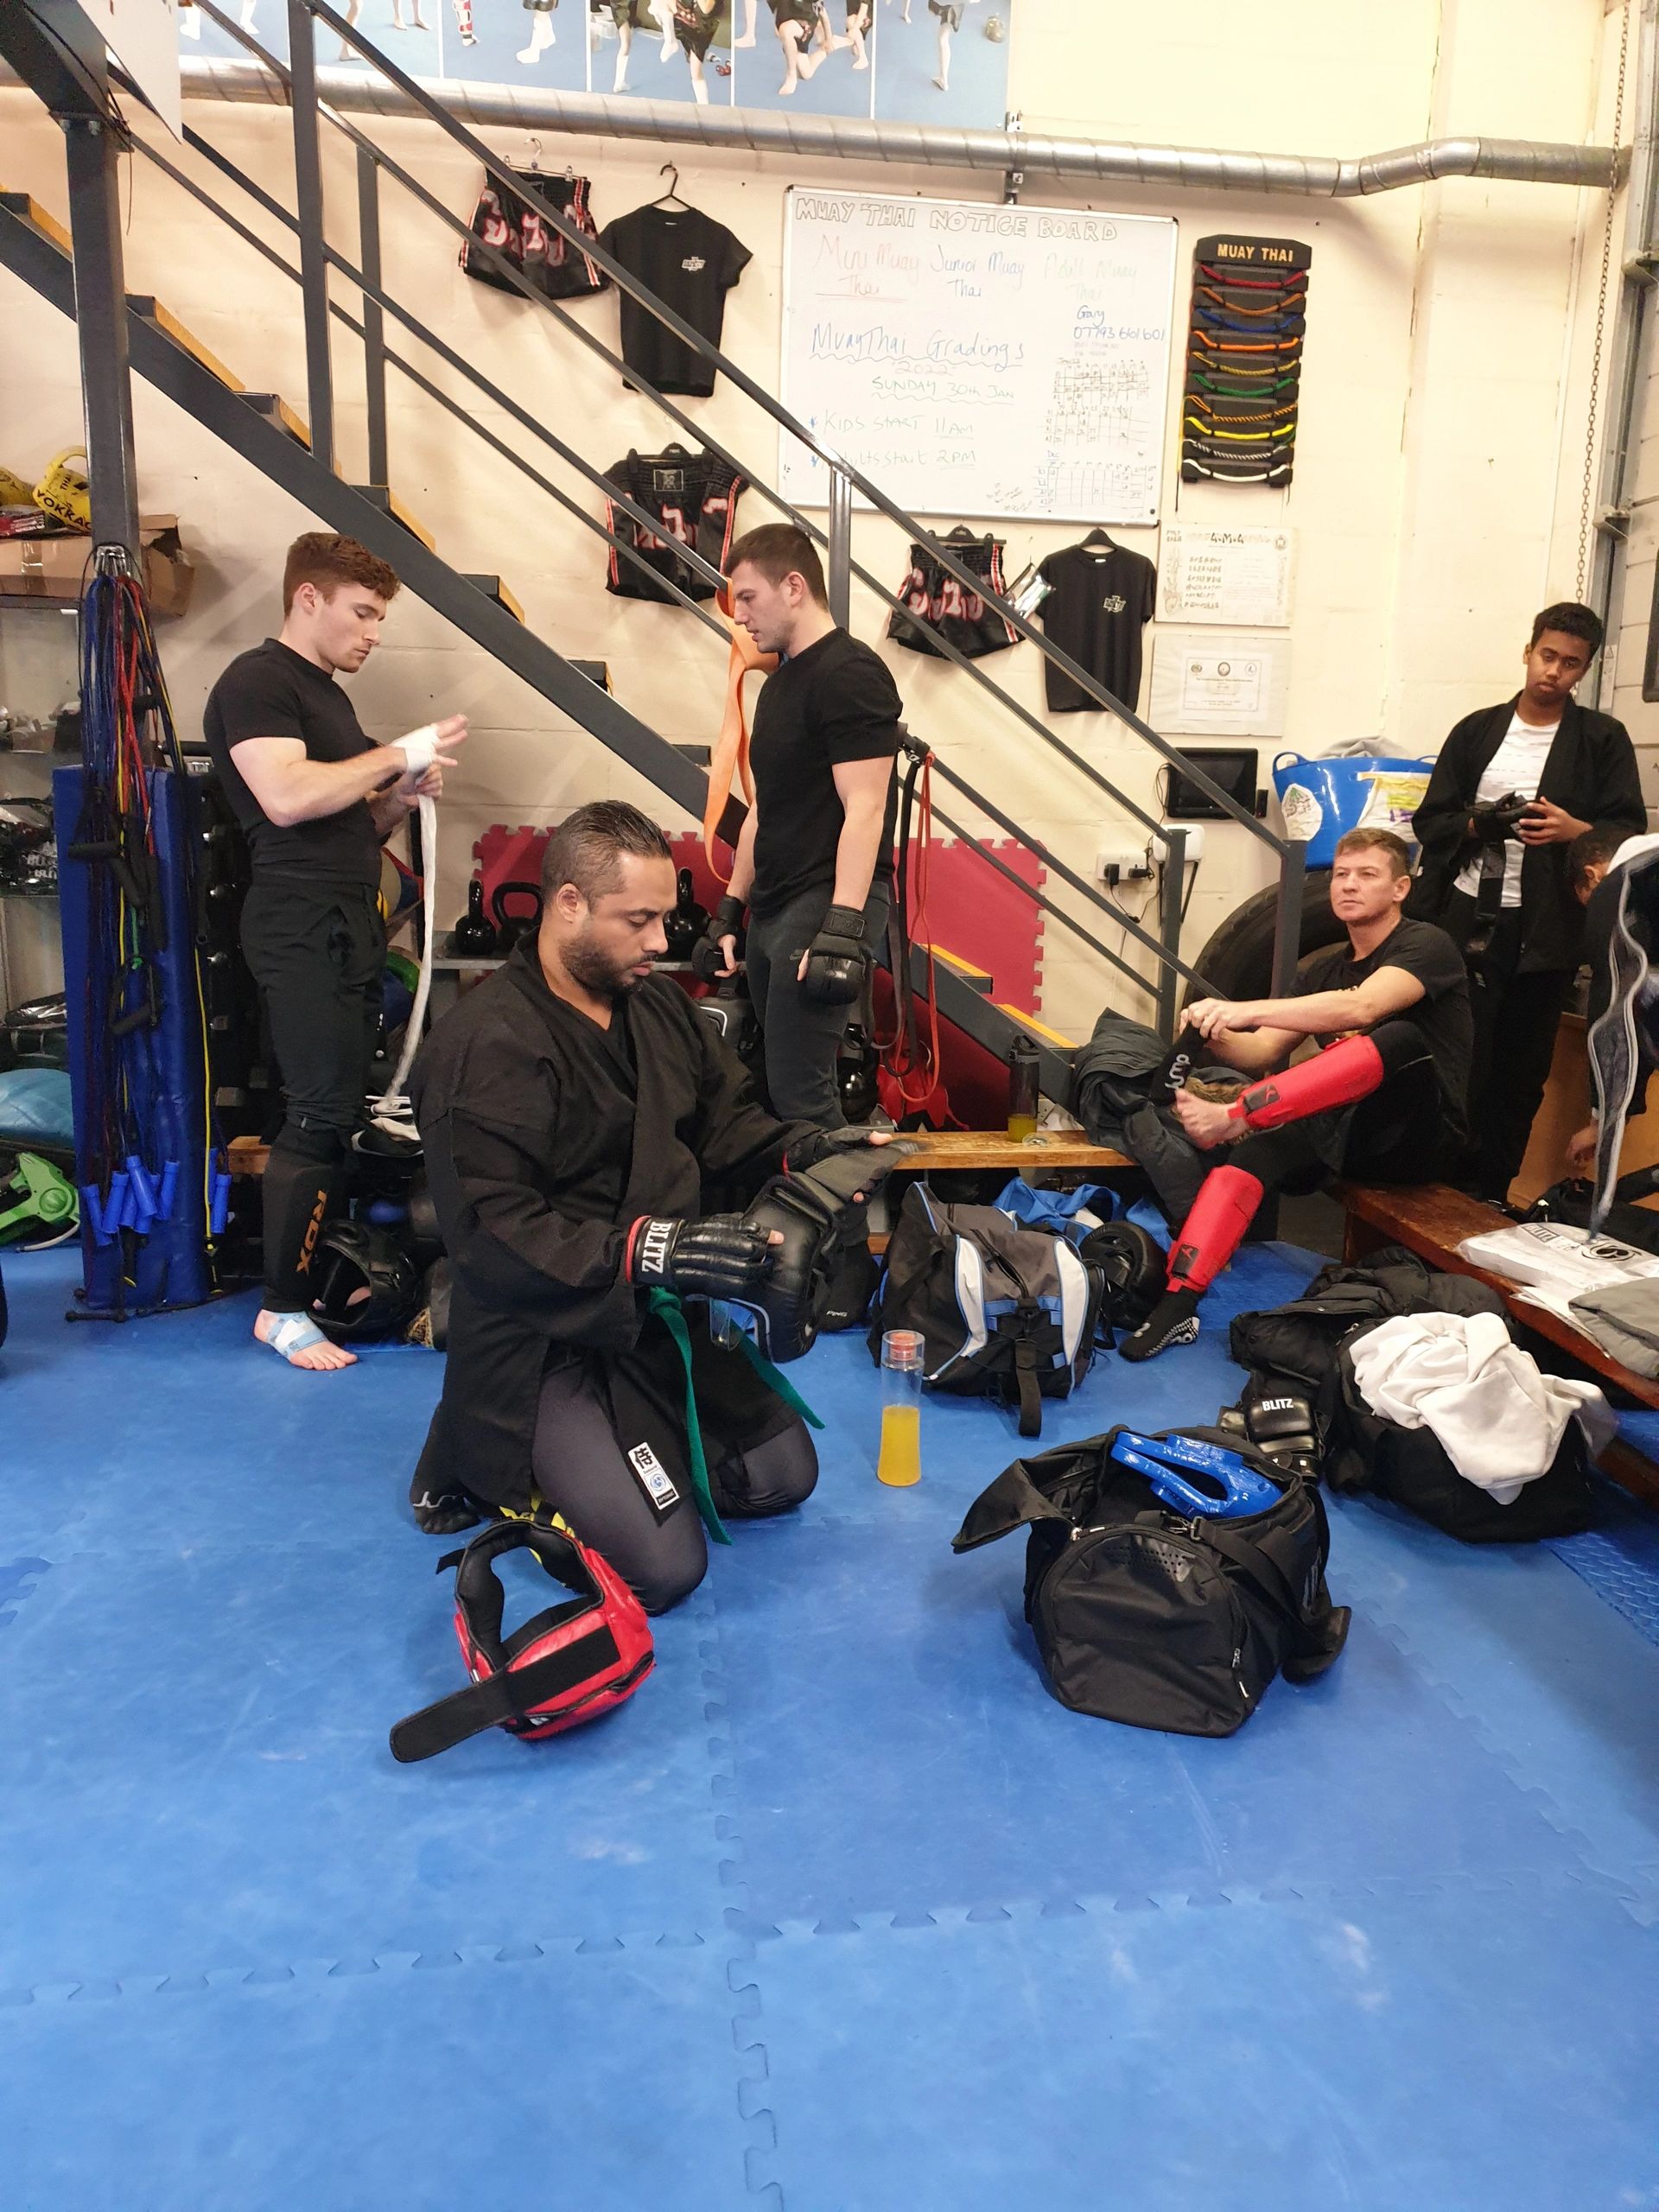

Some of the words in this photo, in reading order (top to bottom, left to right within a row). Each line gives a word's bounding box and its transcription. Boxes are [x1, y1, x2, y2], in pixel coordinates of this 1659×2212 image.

[796, 198, 855, 223] MUAY
[861, 204, 916, 227] THAI
[930, 210, 1027, 238] NOTICE
[1037, 217, 1117, 241] BOARD
[930, 244, 976, 273] Junior
[988, 251, 1025, 290] Muay
[1217, 244, 1255, 258] MUAY
[1262, 248, 1294, 263] THAI
[947, 279, 982, 298] Thai
[926, 329, 1024, 372] Gradings
[872, 376, 936, 395] SUNDAY
[824, 409, 864, 434] KIDS
[296, 1190, 327, 1276] RDX
[641, 1221, 673, 1274] BLITZ
[1262, 1398, 1294, 1412] BLITZ
